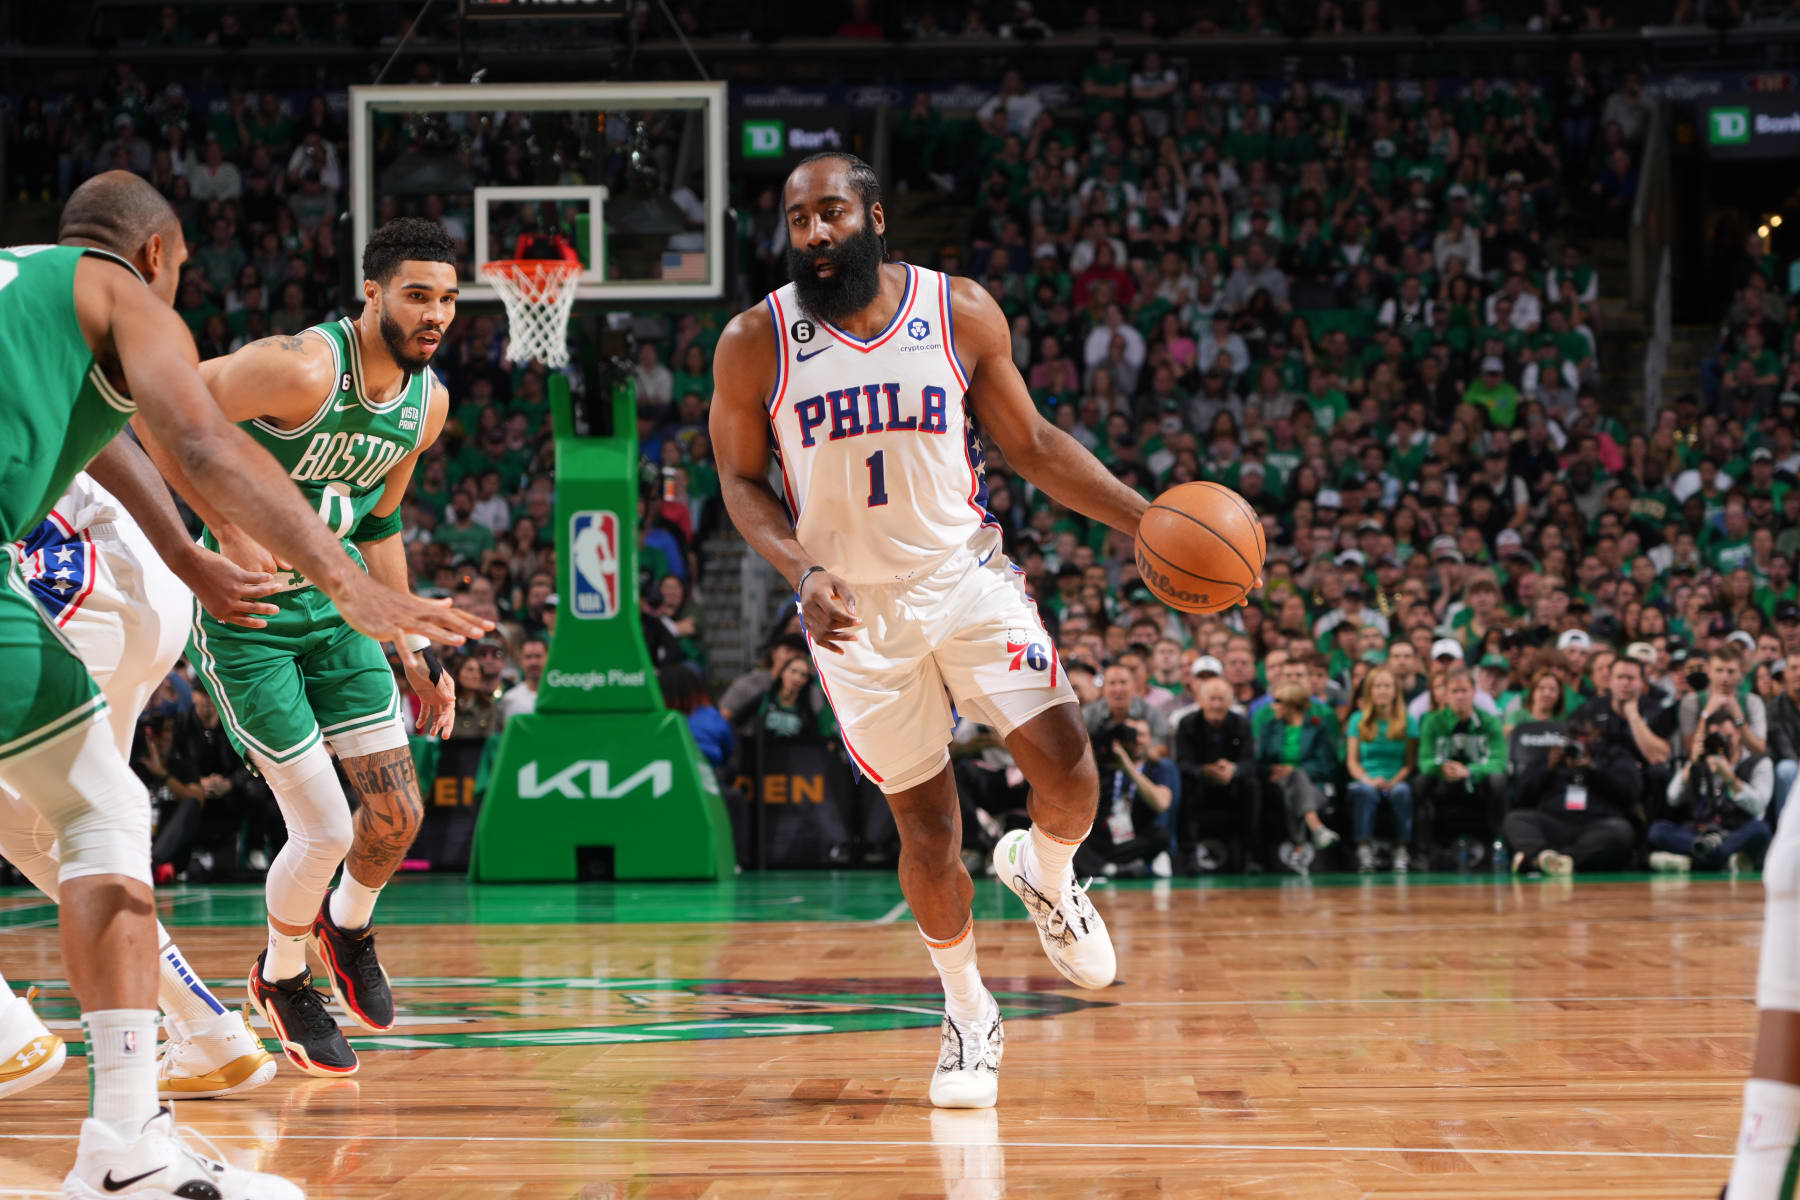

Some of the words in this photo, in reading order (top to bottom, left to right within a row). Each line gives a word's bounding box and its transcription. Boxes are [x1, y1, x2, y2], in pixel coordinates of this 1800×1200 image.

[1712, 112, 1746, 137] TD
[745, 126, 781, 150] TD
[797, 323, 811, 341] 6
[900, 343, 942, 353] crypto.com
[342, 373, 352, 391] 6
[398, 419, 418, 431] PRINT
[401, 406, 419, 420] VISTA
[794, 383, 948, 449] PHILA
[290, 431, 410, 489] BOSTON
[866, 450, 889, 508] 1
[318, 482, 354, 539] 0
[1138, 548, 1211, 605] Wilson
[1007, 640, 1049, 673] 76
[547, 668, 607, 691] Google
[607, 667, 646, 687] Pixel
